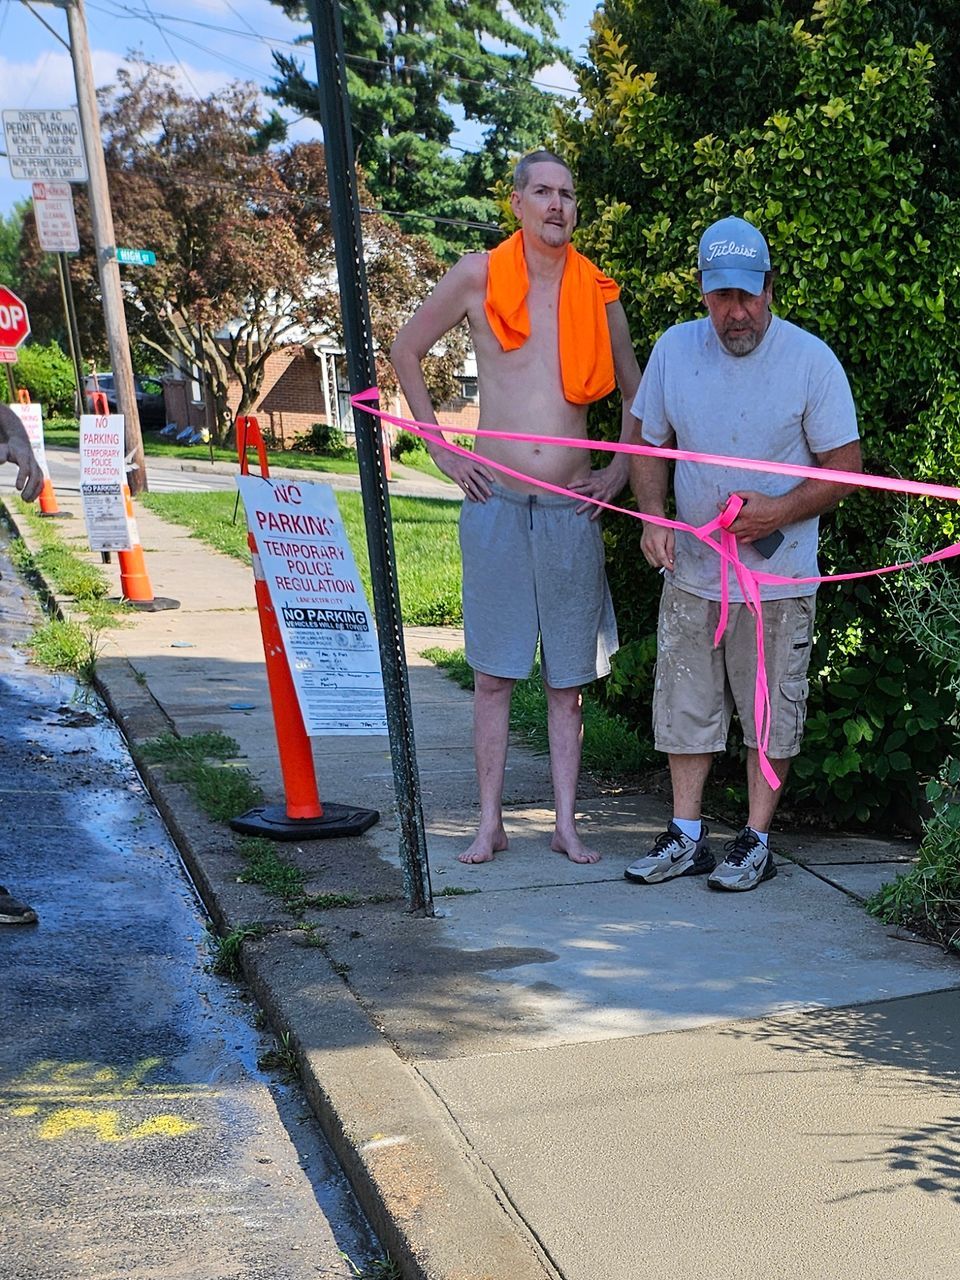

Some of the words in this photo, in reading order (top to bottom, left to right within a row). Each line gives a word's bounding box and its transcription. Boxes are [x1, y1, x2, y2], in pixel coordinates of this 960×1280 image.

[18, 111, 46, 121] DISTRICT
[6, 121, 37, 135] PERMIT
[40, 122, 78, 136] PARKING
[33, 184, 46, 198] NO
[120, 249, 142, 262] HIGH
[706, 239, 757, 262] Titleist
[95, 417, 109, 429] NO
[83, 433, 119, 445] PARKING
[83, 449, 119, 458] TEMPORARY
[91, 457, 112, 467] POLICE
[83, 467, 119, 476] REGULATION
[273, 484, 302, 505] NO
[263, 540, 345, 561] TEMPORARY
[287, 559, 334, 576] POLICE
[275, 575, 356, 594] REGULATION
[283, 608, 305, 621] NO
[307, 610, 366, 625] PARKING
[285, 620, 319, 629] VEHICLES
[319, 622, 335, 630] WILL
